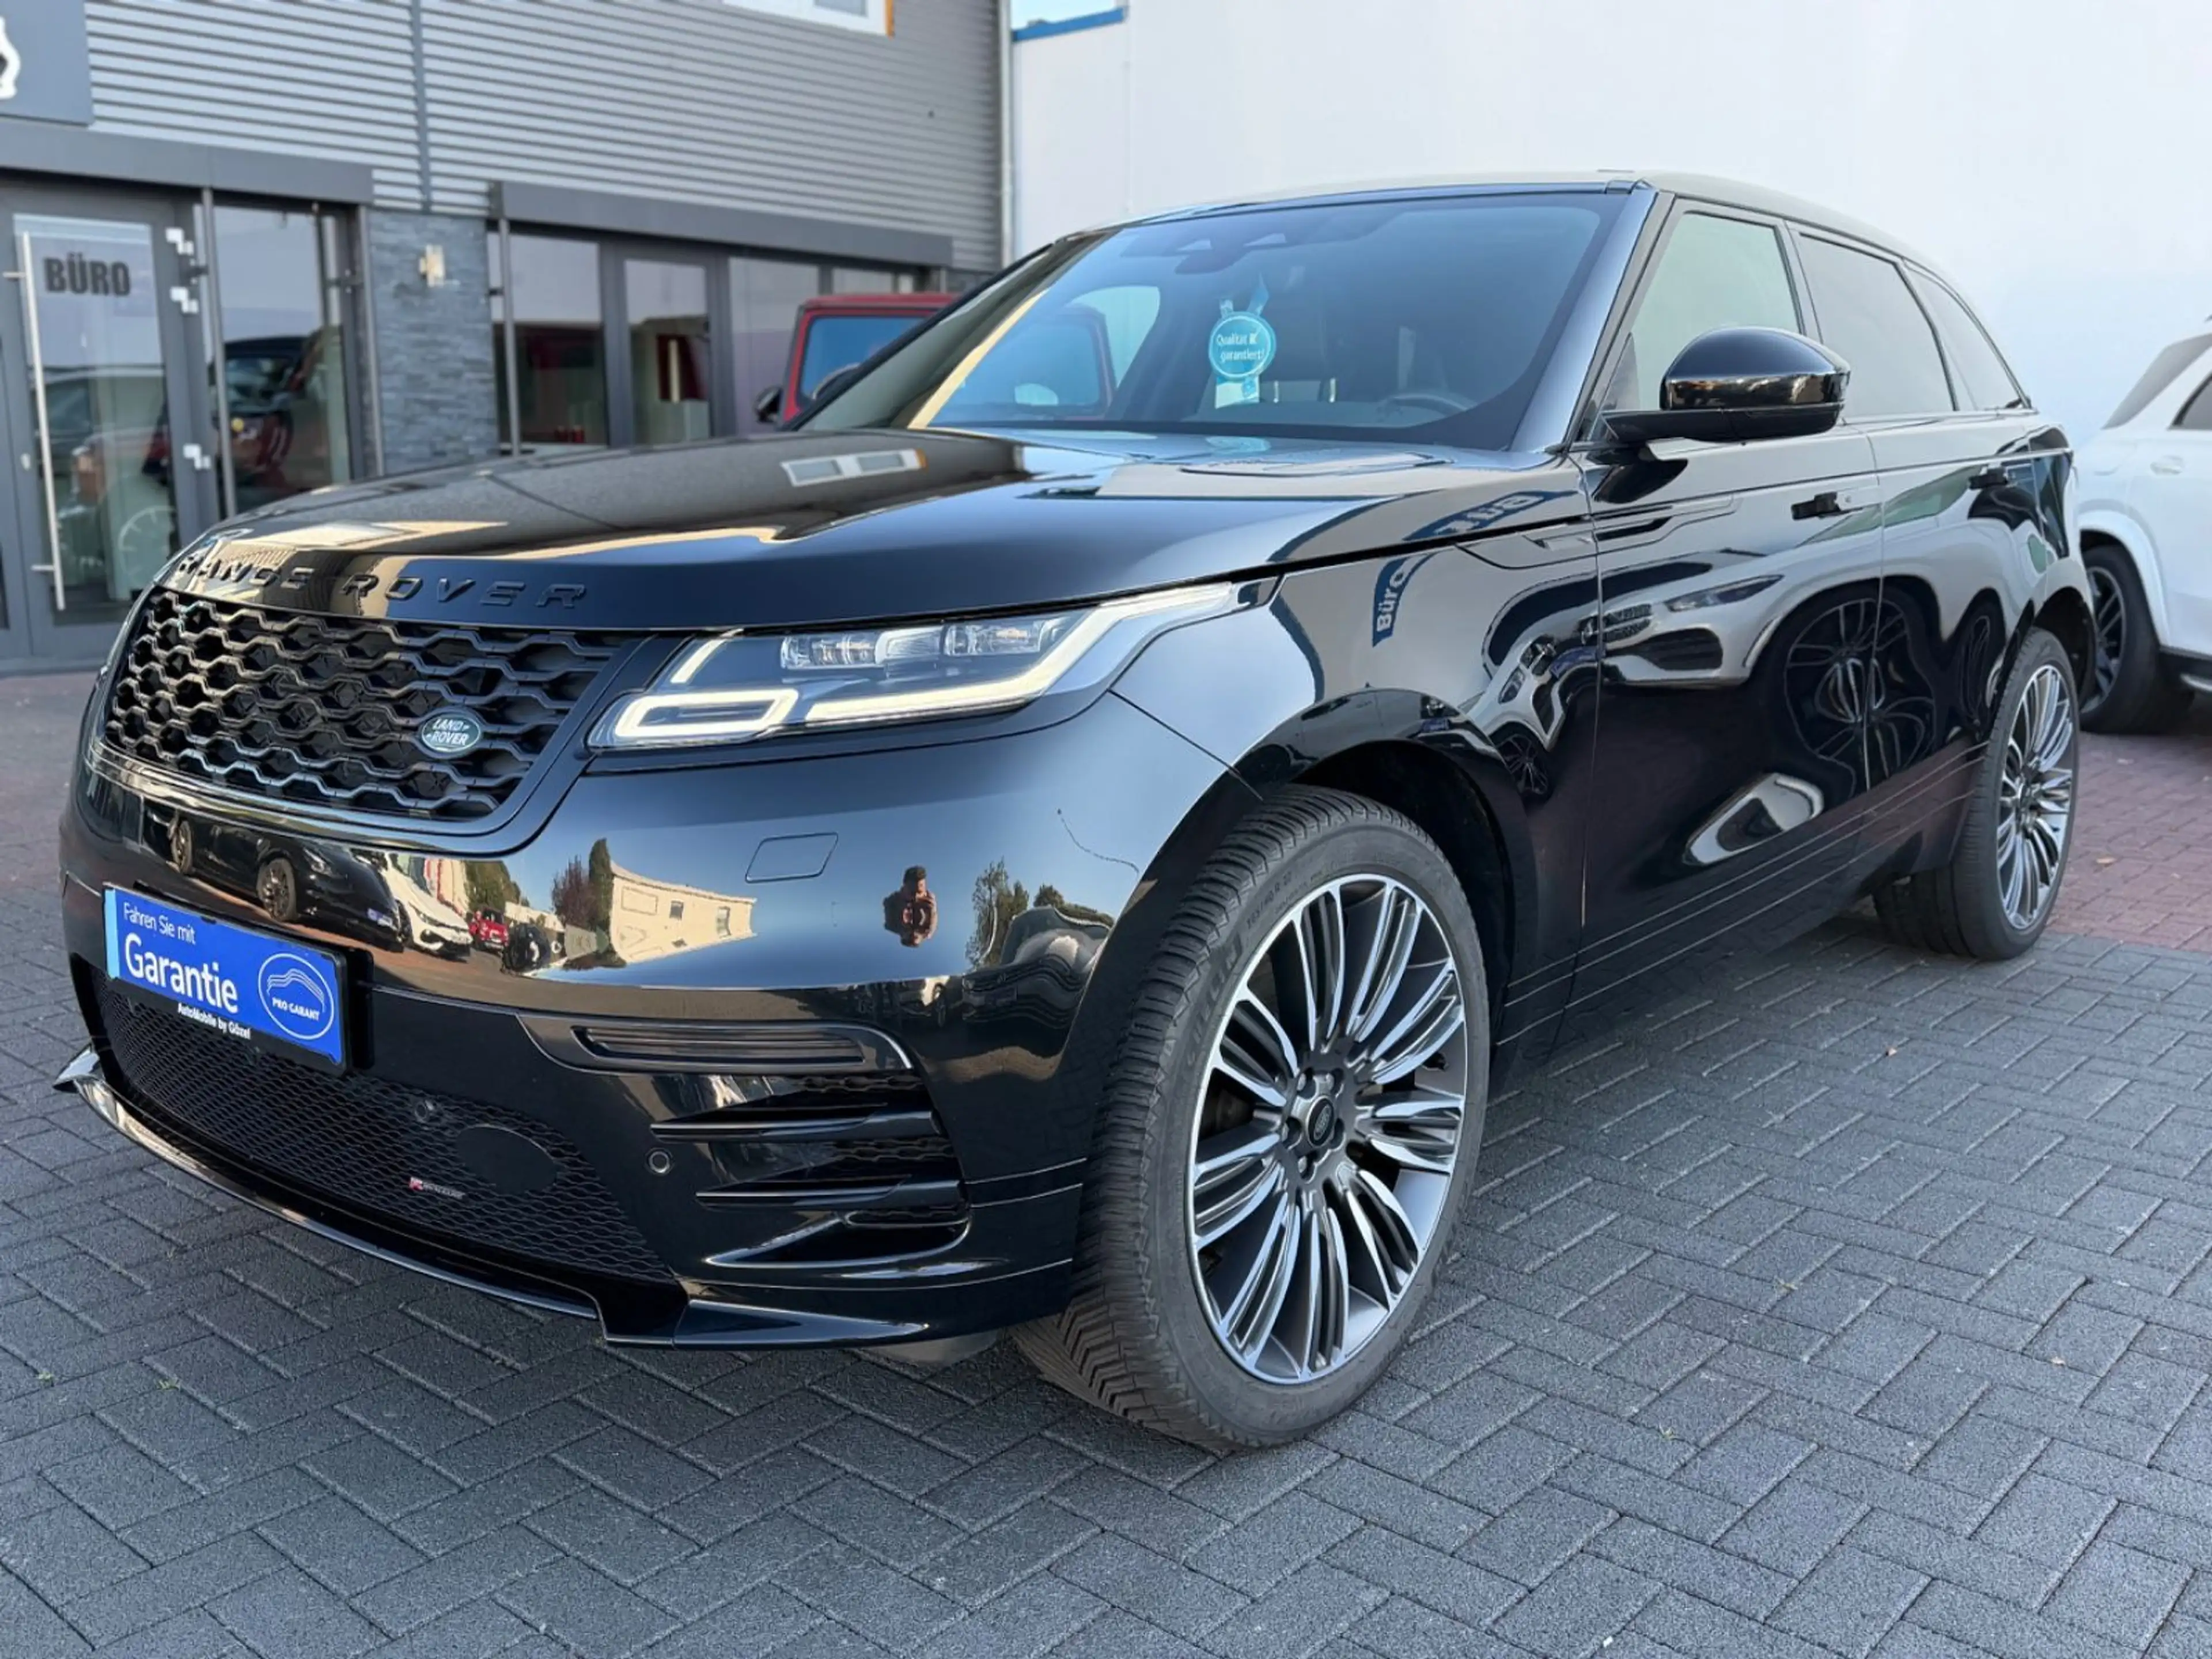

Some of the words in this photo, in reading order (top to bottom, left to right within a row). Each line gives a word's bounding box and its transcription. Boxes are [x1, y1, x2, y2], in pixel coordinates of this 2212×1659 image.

[44, 252, 131, 296] BÜRO
[341, 573, 586, 608] ROVER
[430, 731, 469, 745] ROVER
[123, 901, 157, 931] Fahren
[158, 915, 175, 938] Sie
[177, 924, 196, 945] mit
[124, 932, 238, 1014] Garantie
[218, 1016, 228, 1034] by
[272, 997, 288, 1012] PRO
[288, 1002, 320, 1021] GARANT
